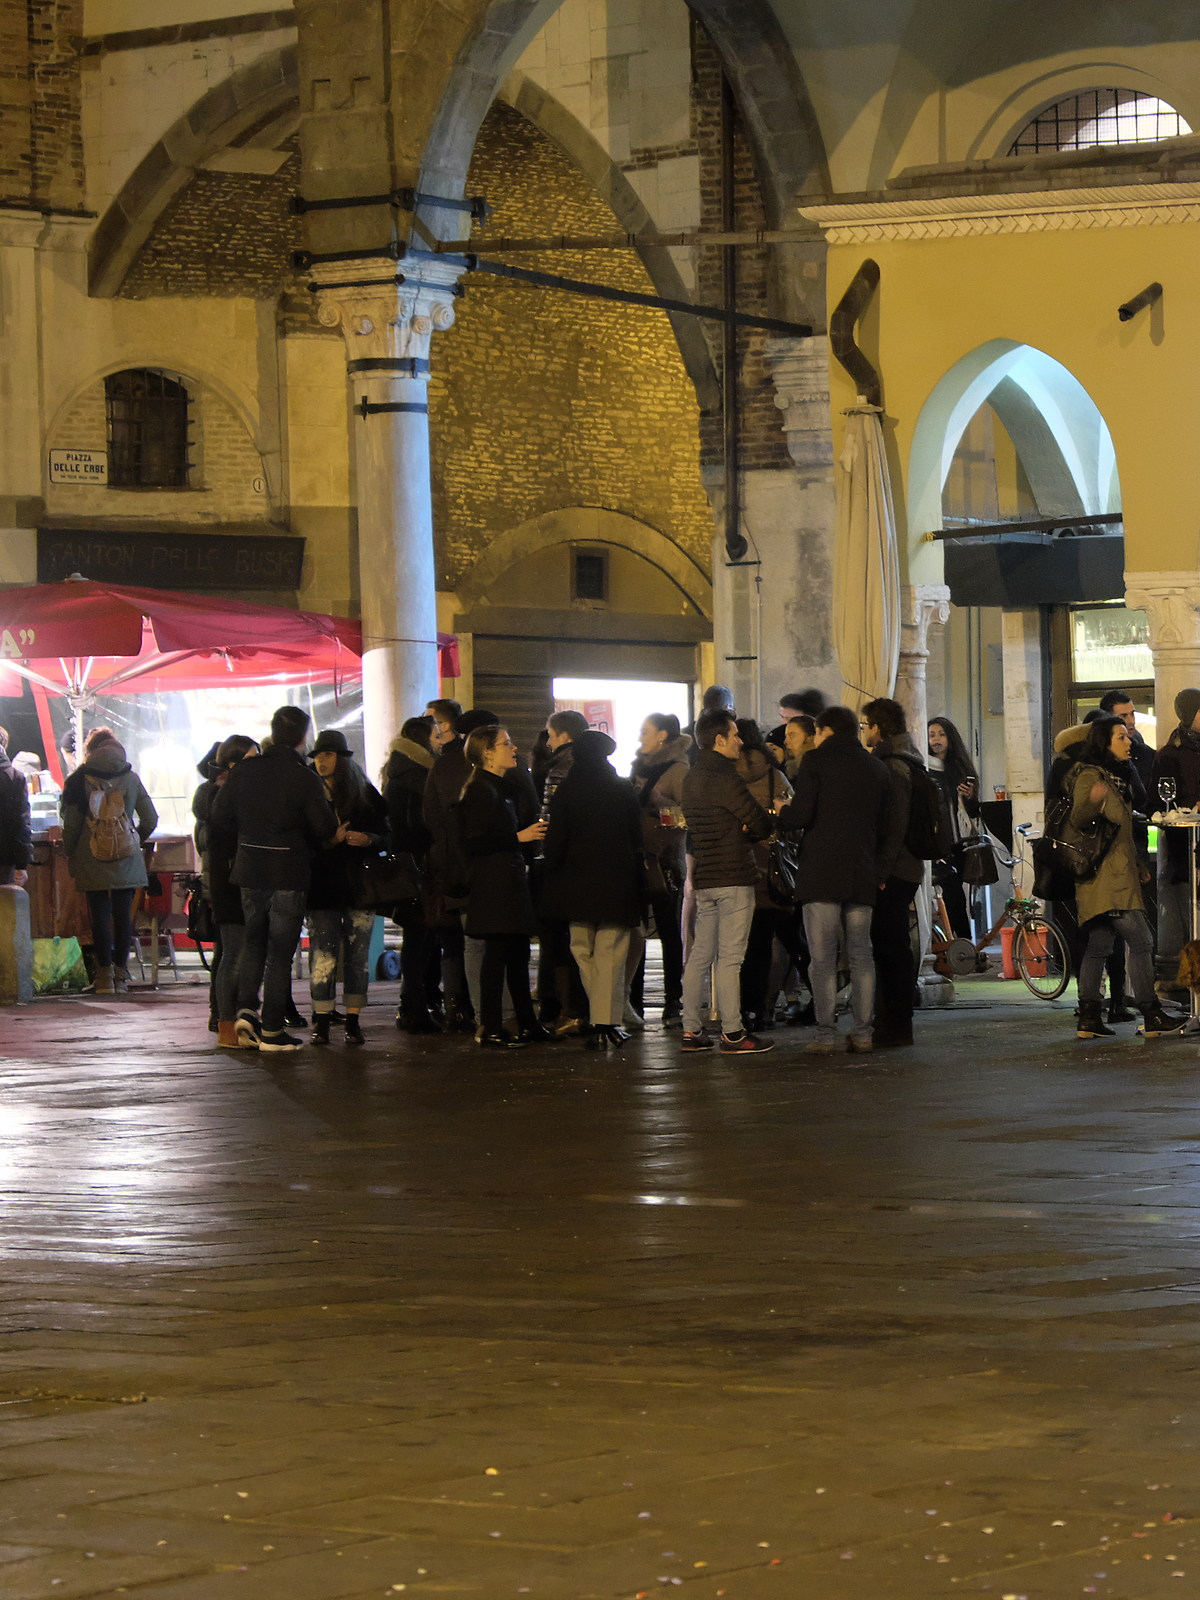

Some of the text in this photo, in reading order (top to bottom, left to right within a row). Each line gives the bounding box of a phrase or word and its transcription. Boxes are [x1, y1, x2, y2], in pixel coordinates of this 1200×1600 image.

[66, 453, 92, 462] PIAZZA
[54, 463, 105, 474] DELLE ERBE
